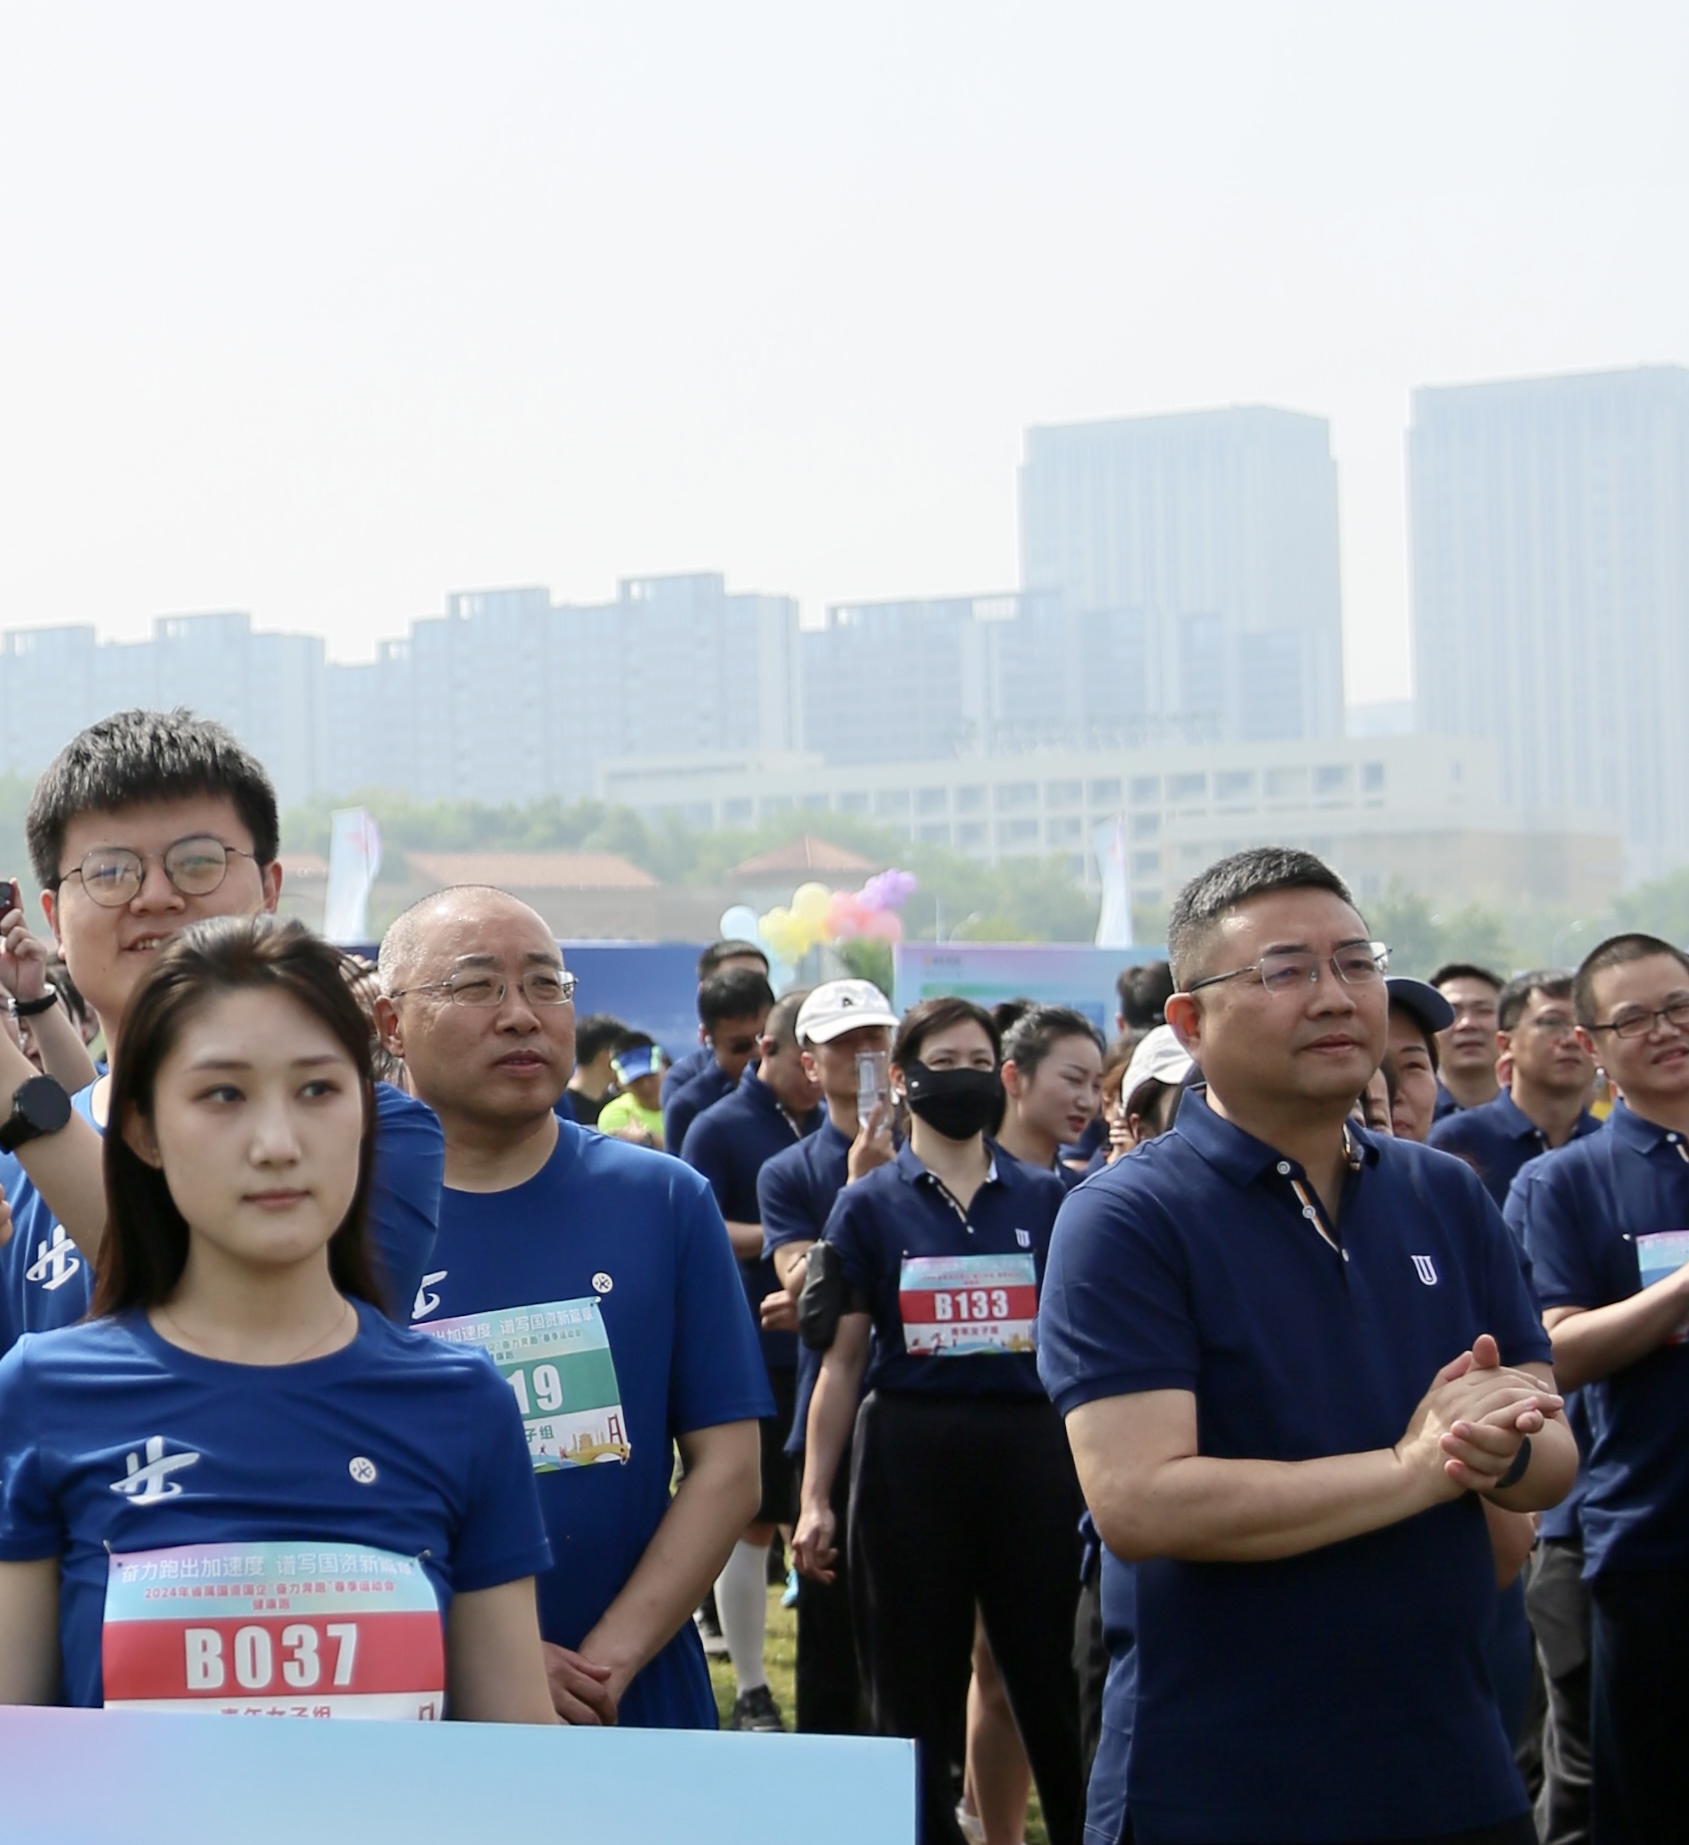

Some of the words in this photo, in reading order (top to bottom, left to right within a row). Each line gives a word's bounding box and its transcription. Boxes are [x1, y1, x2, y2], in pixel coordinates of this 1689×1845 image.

[934, 1289, 1009, 1321] B133
[121, 1555, 265, 1583] 奋力跑出加速度
[184, 1622, 358, 1691] B037
